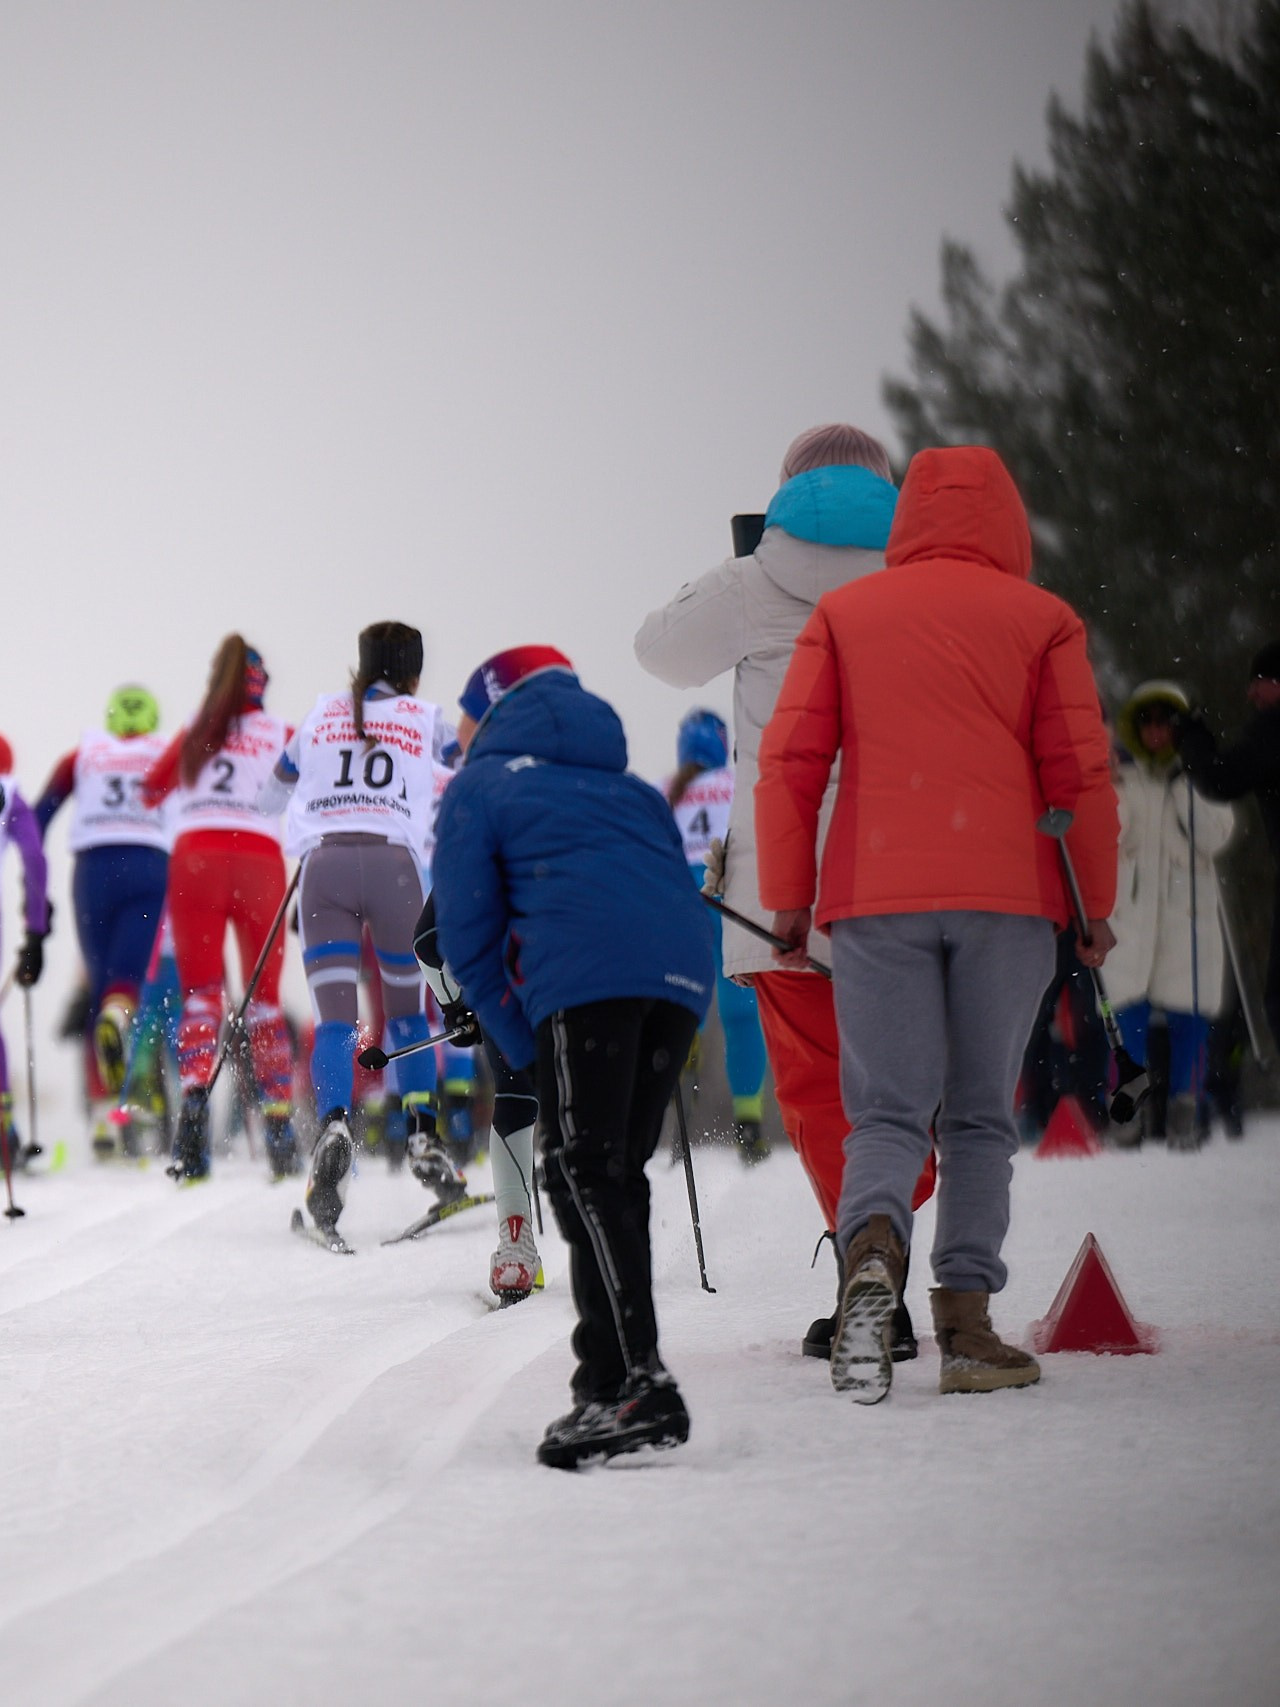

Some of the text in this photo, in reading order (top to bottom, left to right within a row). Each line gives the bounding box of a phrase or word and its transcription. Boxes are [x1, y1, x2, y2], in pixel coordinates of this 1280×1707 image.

[213, 759, 235, 793] 2
[334, 749, 393, 788] 10
[687, 808, 710, 836] 4
